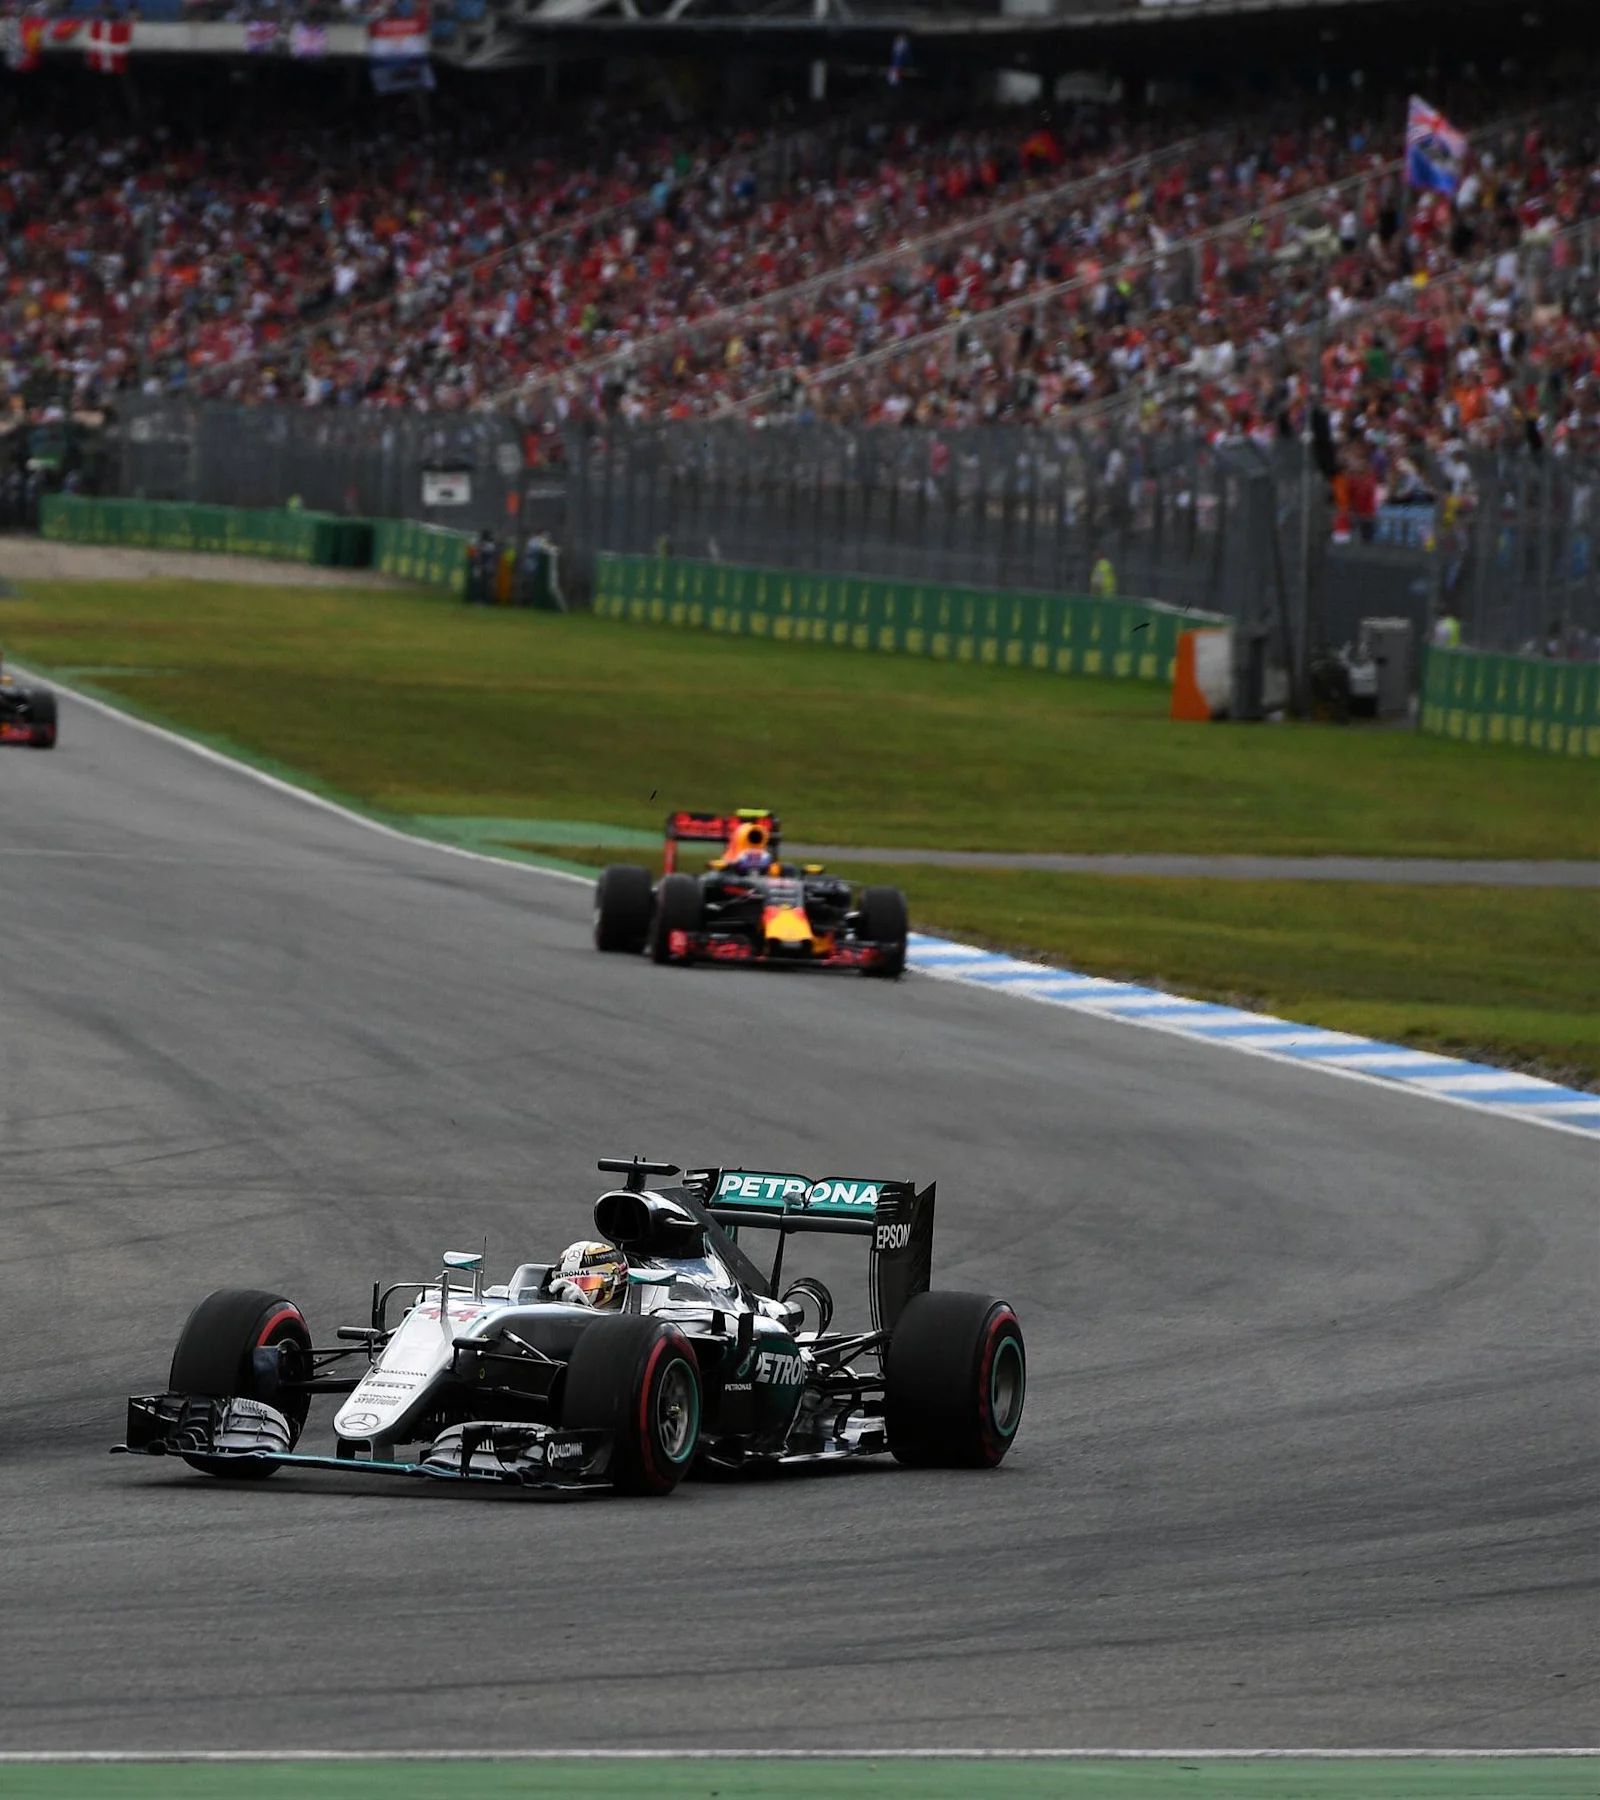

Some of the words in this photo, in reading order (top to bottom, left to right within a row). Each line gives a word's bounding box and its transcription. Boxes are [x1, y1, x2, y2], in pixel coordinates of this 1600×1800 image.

[719, 1175, 878, 1206] PETRONA
[876, 1223, 912, 1250] EPSON
[364, 1380, 416, 1390] PIRELLI
[724, 1382, 752, 1392] PETRONAS
